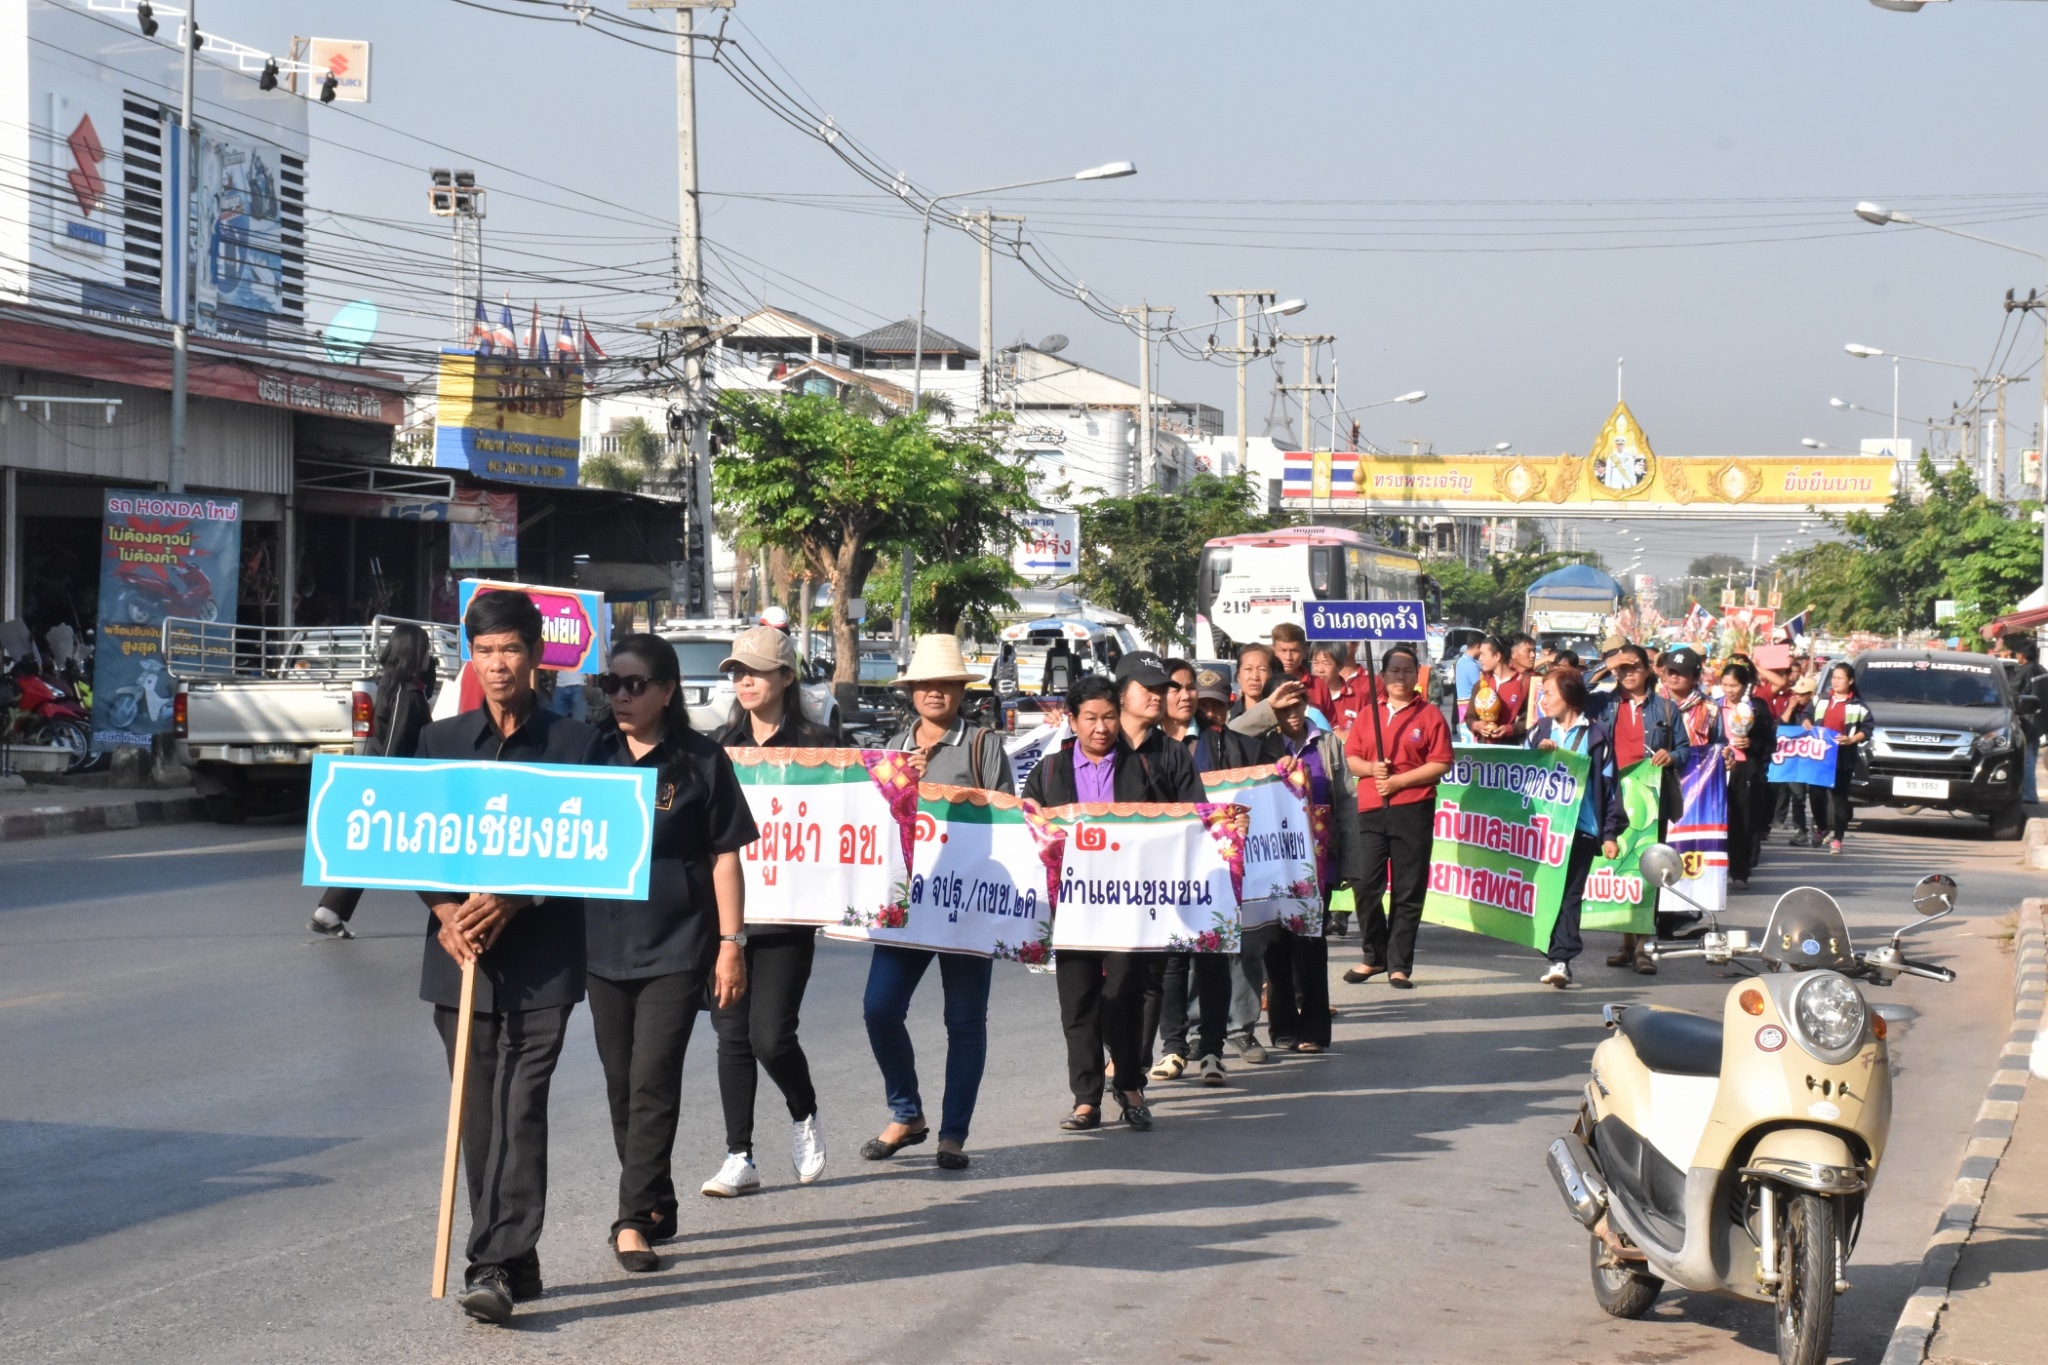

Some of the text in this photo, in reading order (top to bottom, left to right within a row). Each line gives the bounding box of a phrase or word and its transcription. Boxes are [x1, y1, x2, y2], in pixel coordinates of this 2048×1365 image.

[315, 76, 362, 88] SUKI
[1373, 470, 1473, 495] ทรงพระเจริญ
[1784, 466, 1872, 492] ยิ่งยืนนาน
[109, 498, 238, 520] รถ HONDA ใหม่
[1021, 518, 1054, 527] ตลาด
[108, 526, 191, 546] ไม่ต้องดาวน์
[1223, 601, 1250, 613] 219
[1312, 605, 1418, 637] อำเภอกุดรัง
[122, 641, 157, 656] สูงสุด
[1930, 662, 1991, 674] LIFESTYLE
[1904, 734, 1941, 743] ISUZU
[346, 788, 608, 861] อำเภอเชียงยืน
[838, 823, 883, 866] อช.
[1075, 820, 1121, 852] ๒.
[1058, 866, 1213, 921] ทำแผนชุมชน
